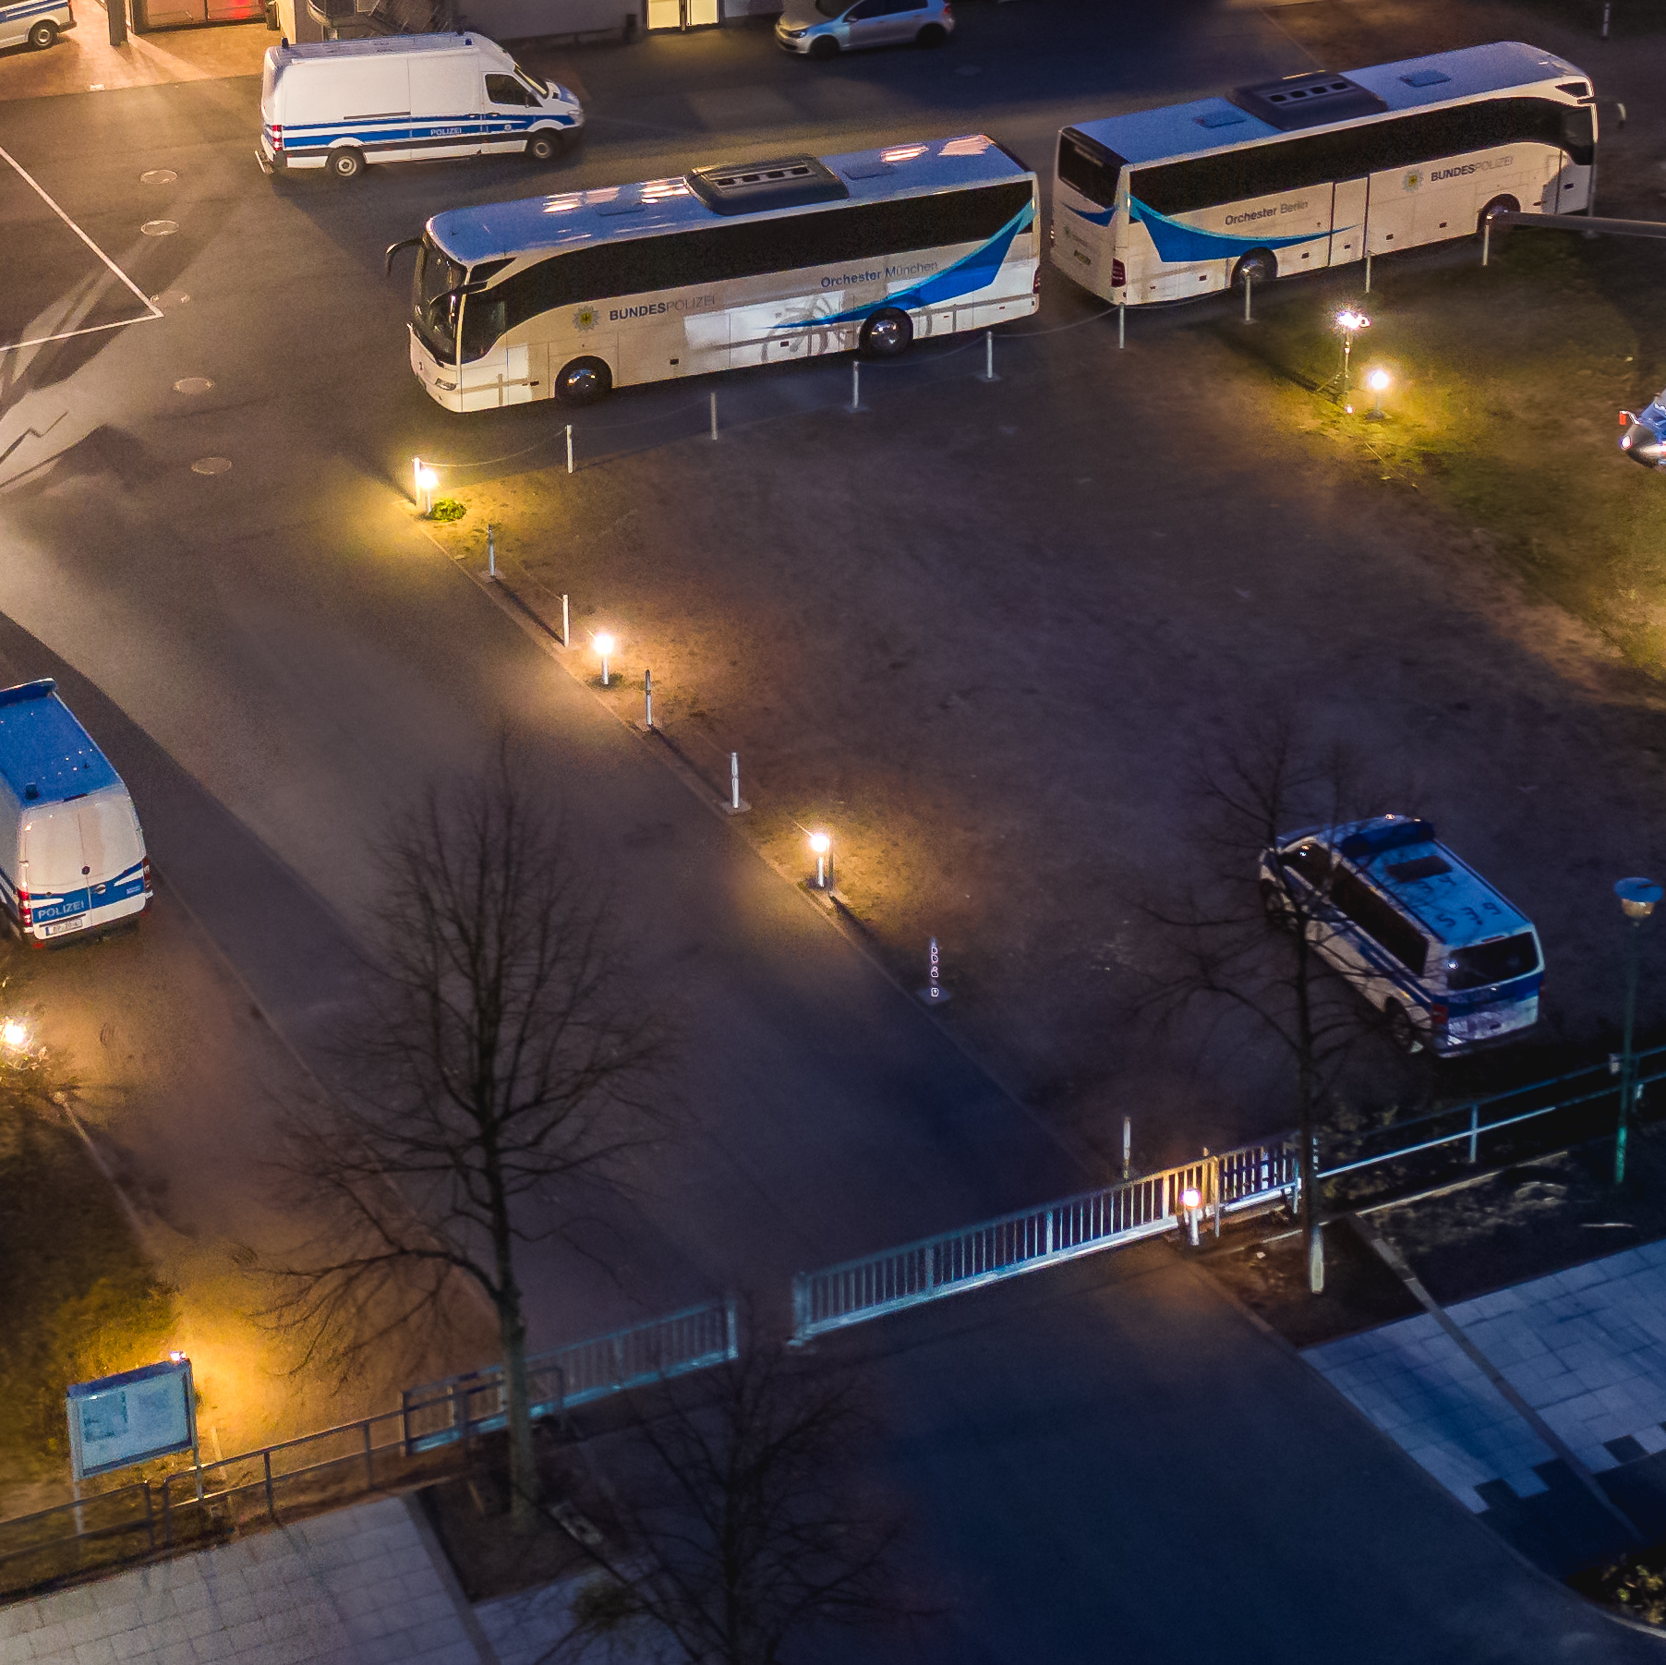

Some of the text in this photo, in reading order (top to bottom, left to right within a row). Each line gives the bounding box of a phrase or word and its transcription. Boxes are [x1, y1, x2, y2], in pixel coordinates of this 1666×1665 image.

[430, 126, 462, 136] POLIZEI
[1430, 155, 1514, 182] BUNDESPOLIZEI
[1224, 200, 1309, 226] Orchester Berlin
[820, 261, 938, 288] Orchester München
[609, 294, 716, 321] BUNDESPOLIZEI
[37, 900, 85, 920] POLIZEI
